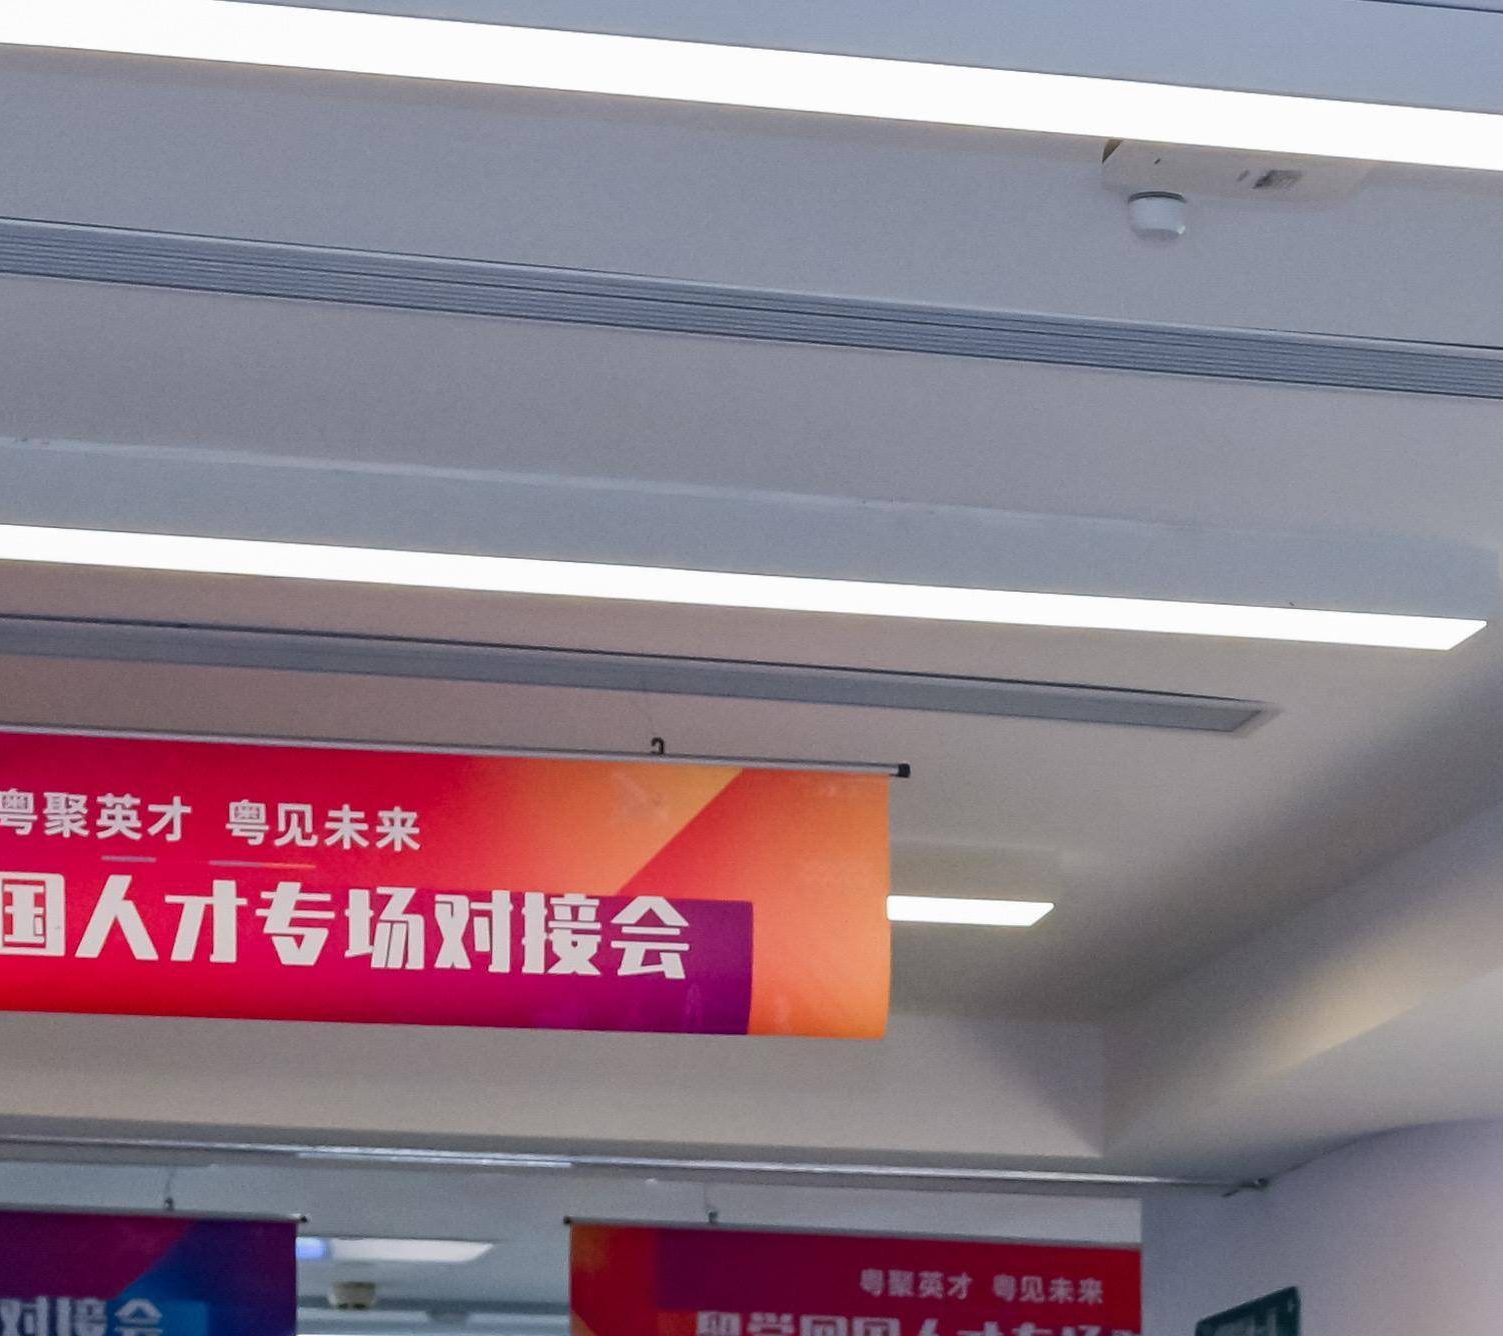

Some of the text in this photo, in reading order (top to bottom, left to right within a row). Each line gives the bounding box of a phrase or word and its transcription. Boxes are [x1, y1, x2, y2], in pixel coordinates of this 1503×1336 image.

[227, 799, 421, 852] 粤见未来
[859, 1267, 1104, 1305] 粤聚英才 粤见未来
